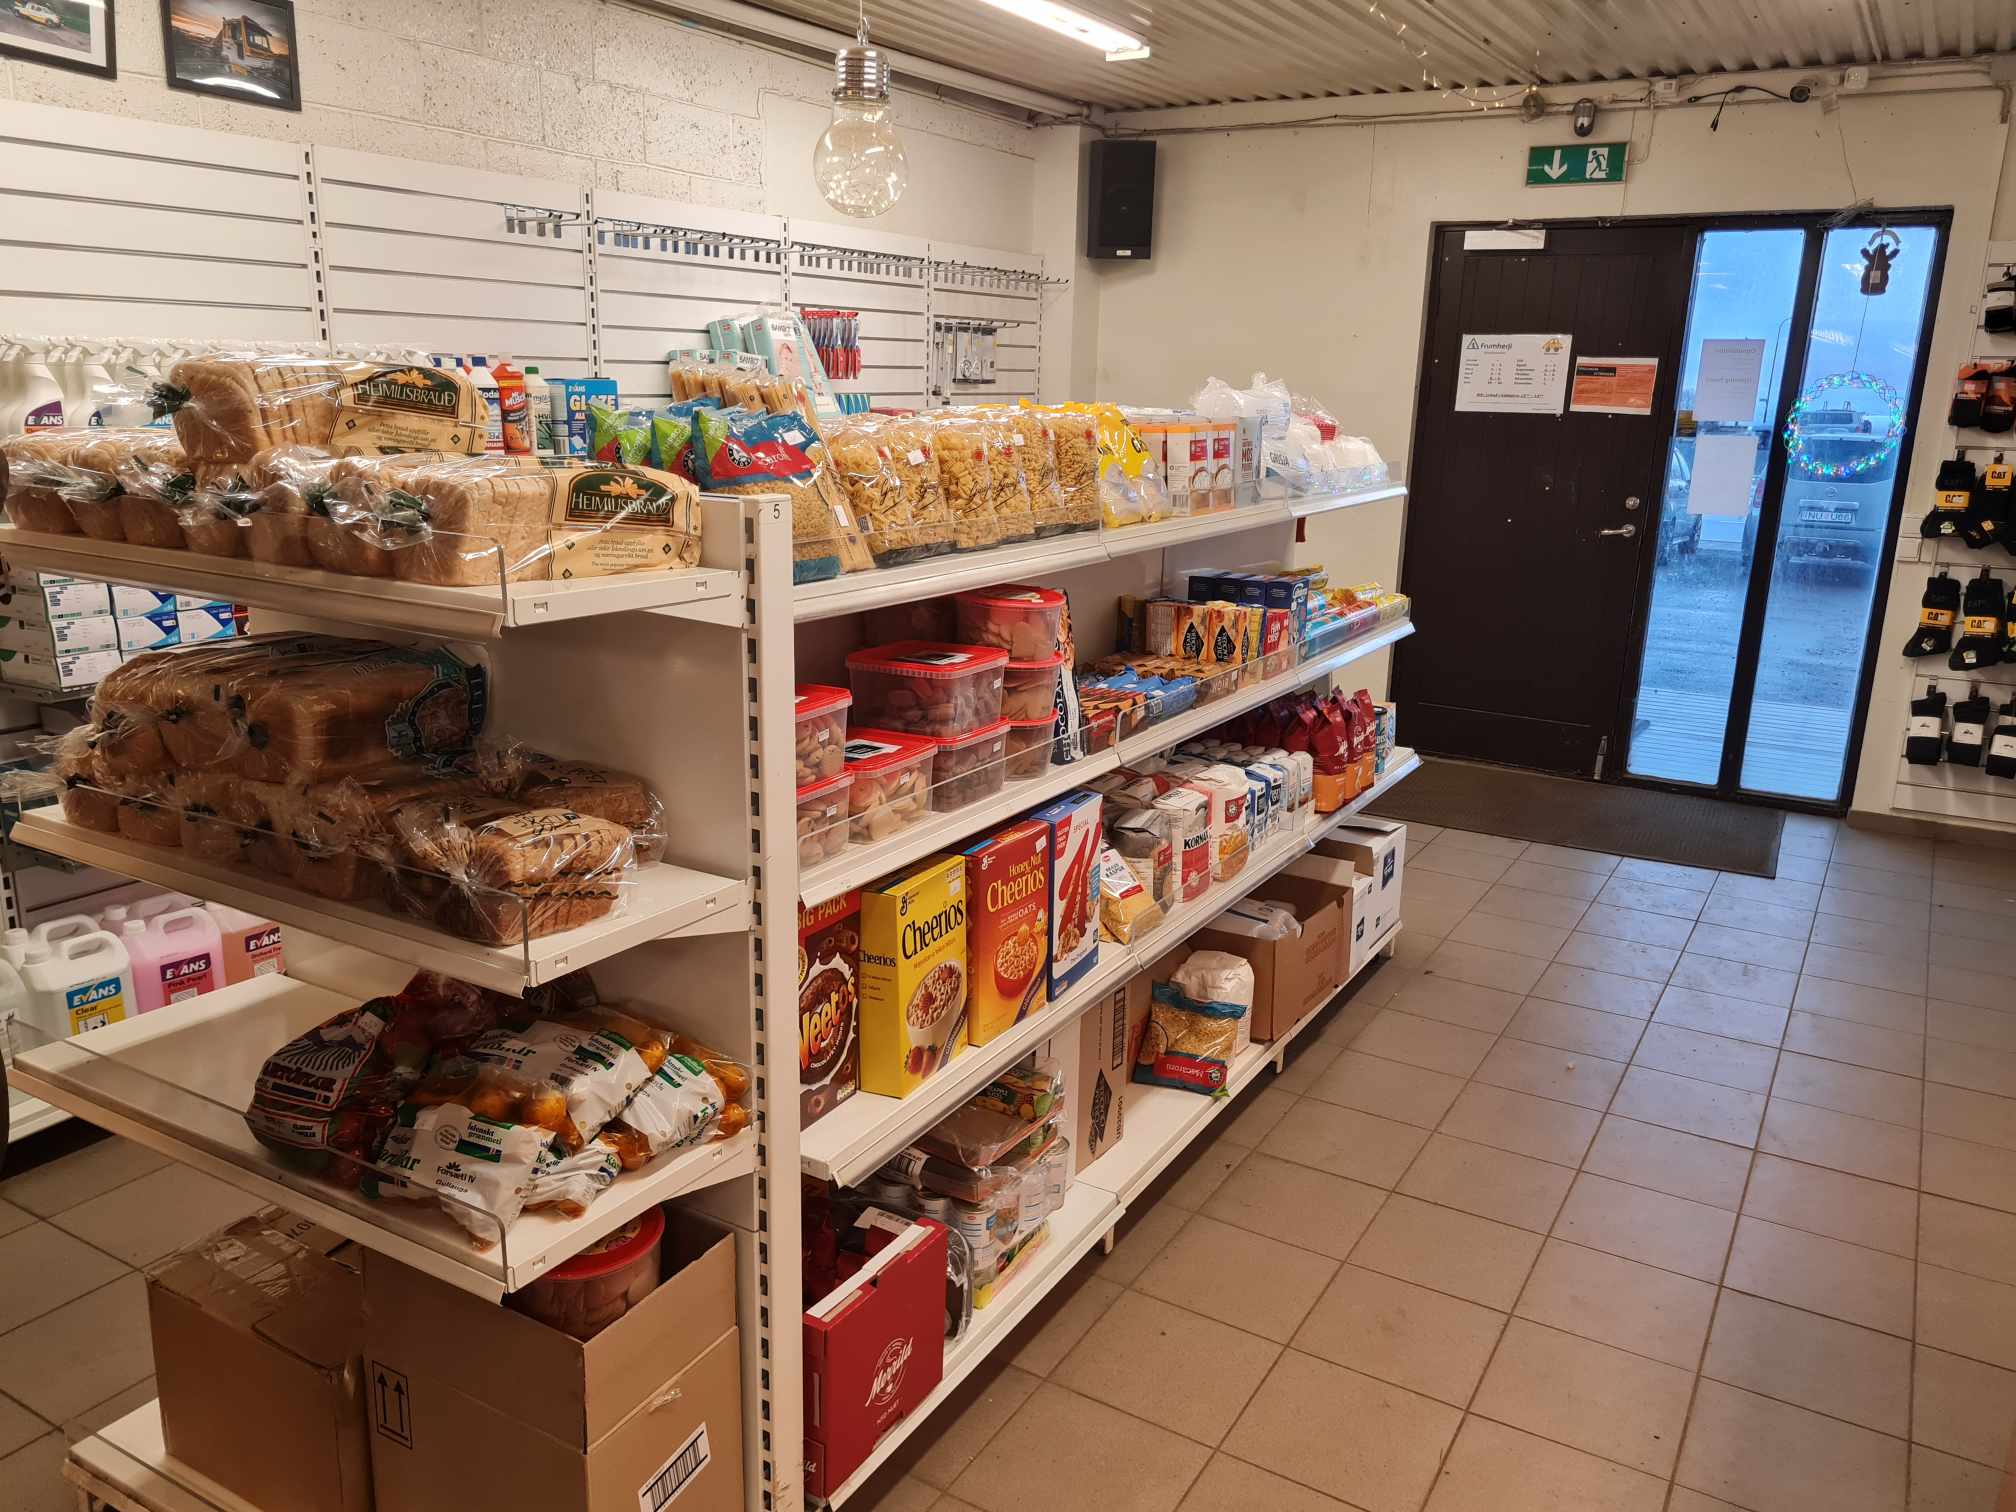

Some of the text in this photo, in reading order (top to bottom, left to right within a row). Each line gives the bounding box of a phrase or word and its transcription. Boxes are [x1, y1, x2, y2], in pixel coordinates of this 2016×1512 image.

[1991, 470, 2007, 479] CAT
[773, 504, 780, 519] 5
[1009, 860, 1030, 878] Honey
[986, 866, 1045, 913] Cheerios
[902, 899, 964, 960] Cheerios
[165, 959, 206, 979] EVANS
[73, 983, 117, 1006] EVANS
[75, 1004, 98, 1016] Clear
[865, 1336, 914, 1407] Merrild
